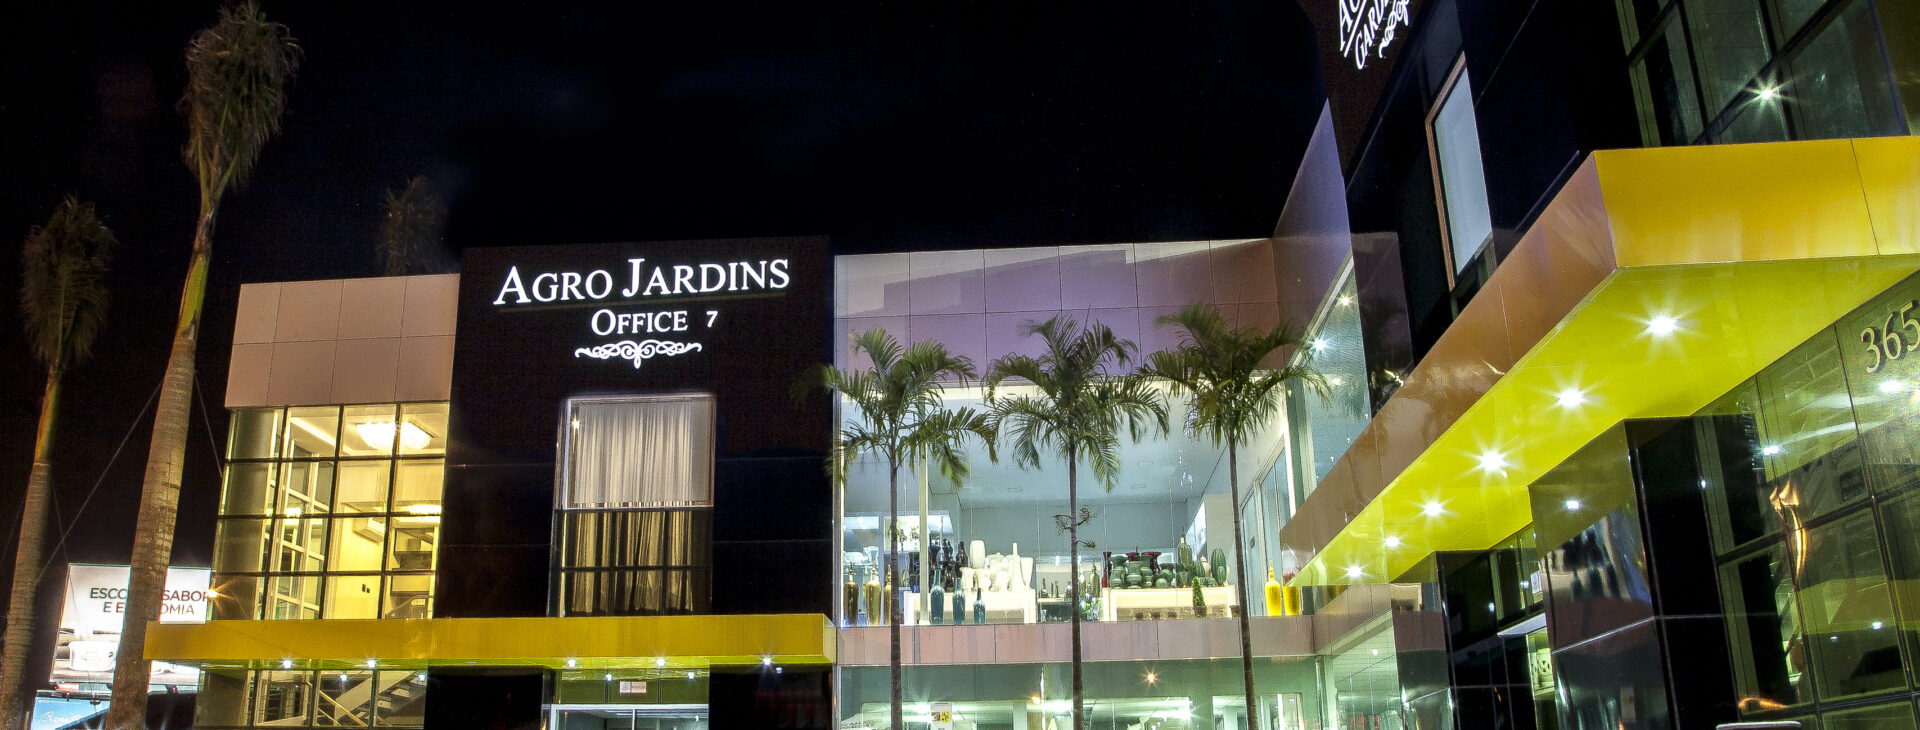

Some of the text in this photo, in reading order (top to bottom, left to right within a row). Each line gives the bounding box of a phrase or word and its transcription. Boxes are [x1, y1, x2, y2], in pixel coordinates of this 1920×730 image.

[706, 310, 719, 328] 7
[1860, 299, 1920, 373] 365
[103, 602, 112, 613] E
